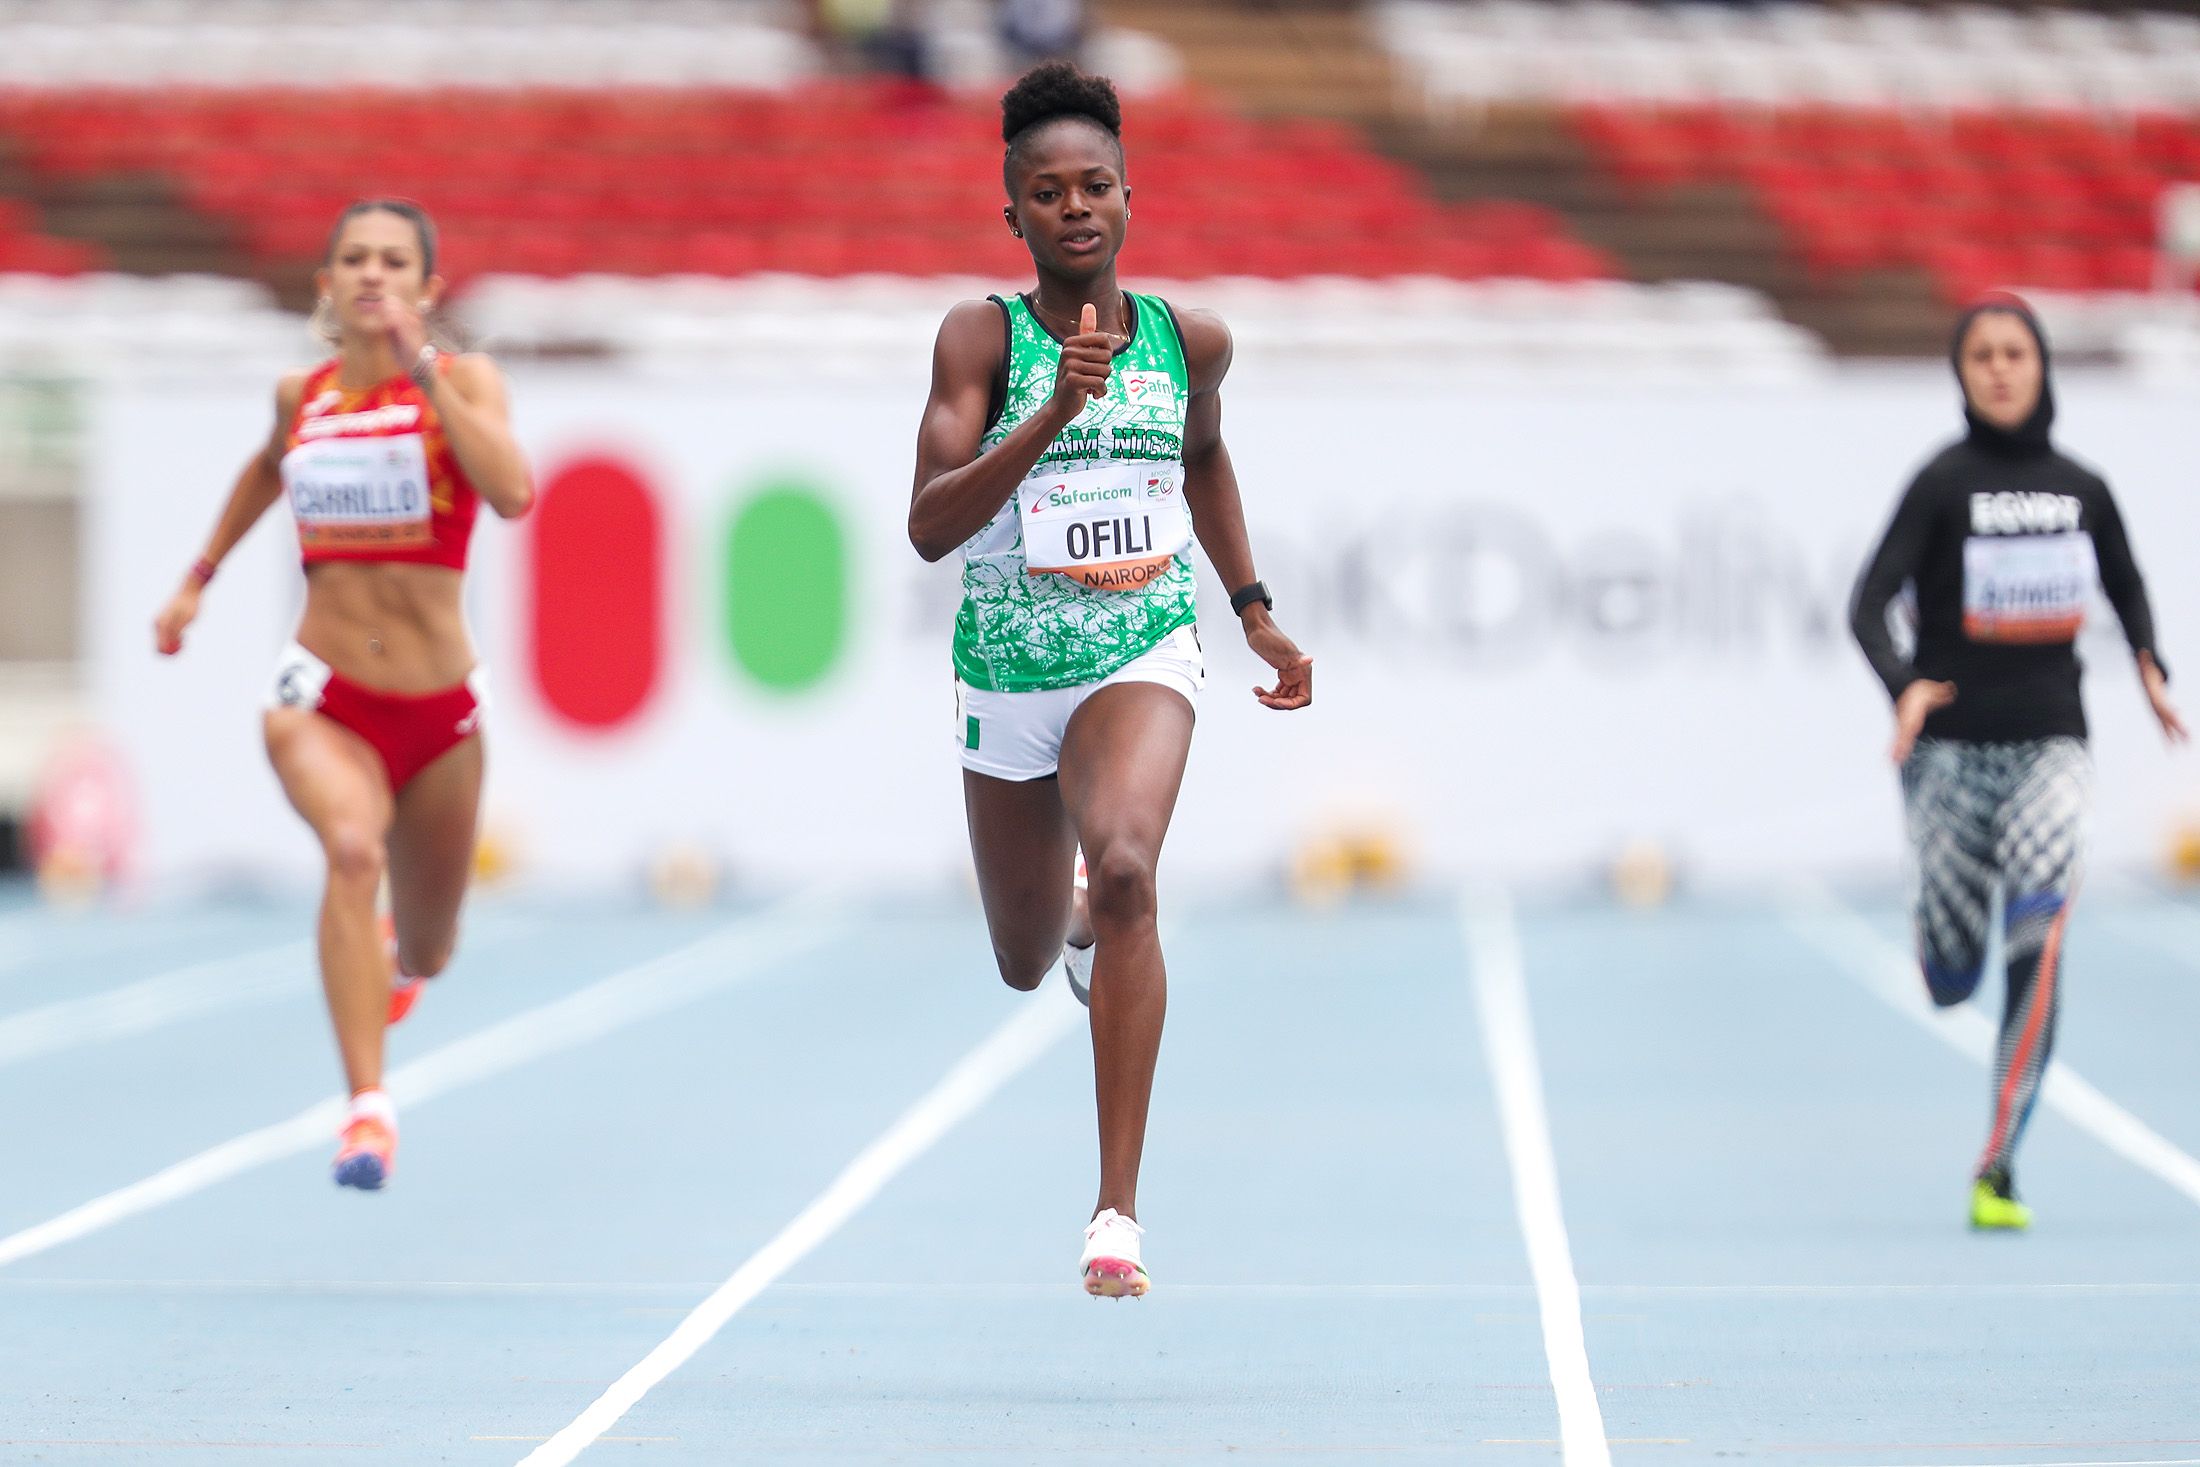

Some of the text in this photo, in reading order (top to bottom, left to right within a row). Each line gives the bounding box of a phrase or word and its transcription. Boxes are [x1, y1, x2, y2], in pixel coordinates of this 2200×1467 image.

[1147, 379, 1171, 395] afn
[1110, 428, 1182, 460] NIGE
[295, 480, 419, 515] CARRILLO
[1049, 487, 1132, 507] Safaricom
[1971, 492, 2081, 533] EGYPT
[1066, 515, 1152, 560] OFILI
